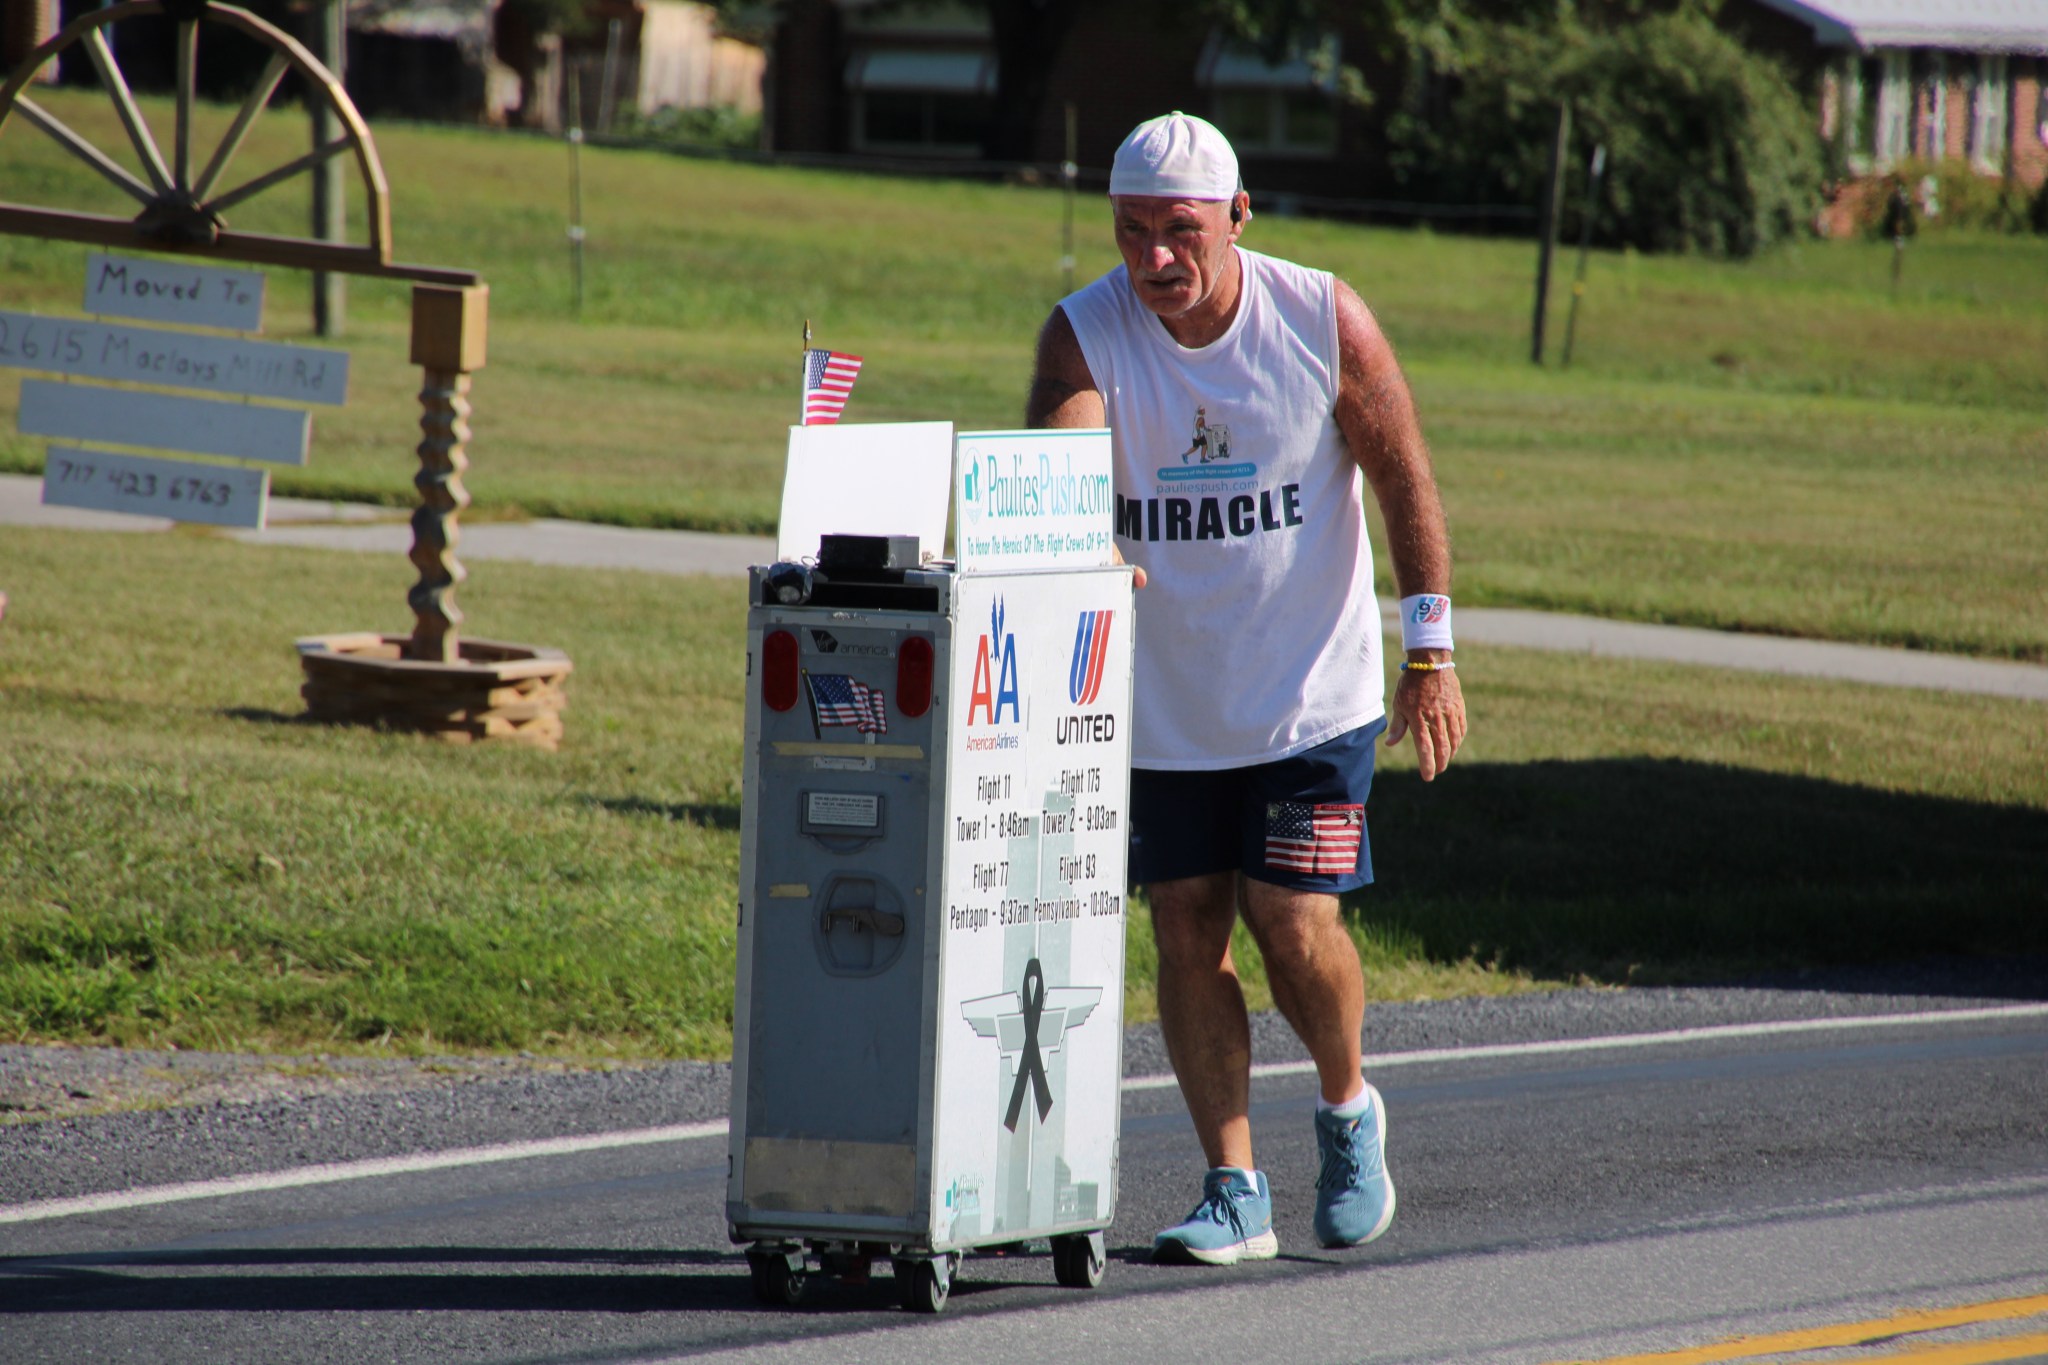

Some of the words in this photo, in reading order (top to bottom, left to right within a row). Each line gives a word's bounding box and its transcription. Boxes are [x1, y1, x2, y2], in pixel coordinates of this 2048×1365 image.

[97, 262, 201, 299] Moved
[222, 278, 250, 306] To
[0, 318, 88, 363] 2615
[290, 359, 327, 390] Rd
[57, 459, 96, 484] 717
[107, 467, 158, 497] 423
[169, 477, 231, 507] 6763
[987, 452, 1112, 518] PauliesPush.com
[1156, 480, 1259, 495] pauliespush.com
[1116, 483, 1304, 542] MIRACLE
[967, 536, 975, 556] To
[975, 535, 990, 556] Honor
[991, 534, 1001, 555] The
[1001, 533, 1022, 554] Heroics
[1024, 533, 1032, 553] Of
[1033, 532, 1045, 553] The
[1047, 531, 1064, 558] Flight
[1065, 532, 1085, 552] Crews
[1086, 530, 1095, 551] Of
[1418, 602, 1443, 616] 93
[840, 642, 889, 657] america
[1056, 714, 1115, 746] UNITED
[977, 774, 1001, 805] Flight
[1004, 773, 1011, 799] 11
[1060, 769, 1084, 799] Flight
[1087, 767, 1101, 793] 175
[957, 816, 981, 842] Tower
[984, 815, 988, 840] 1
[999, 811, 1029, 838] 8:46am
[1042, 809, 1067, 835] Tower
[1069, 807, 1075, 833] 2
[1086, 805, 1117, 832] 9:03am
[973, 862, 996, 893] Flight
[1000, 861, 1009, 887] 77
[1059, 855, 1082, 885] Flight
[1085, 853, 1096, 880] 93
[950, 903, 989, 933] Pentagon
[1000, 899, 1029, 926] 9:37am
[1033, 894, 1080, 925] Pennsylvania
[1090, 890, 1120, 917] 10:03am
